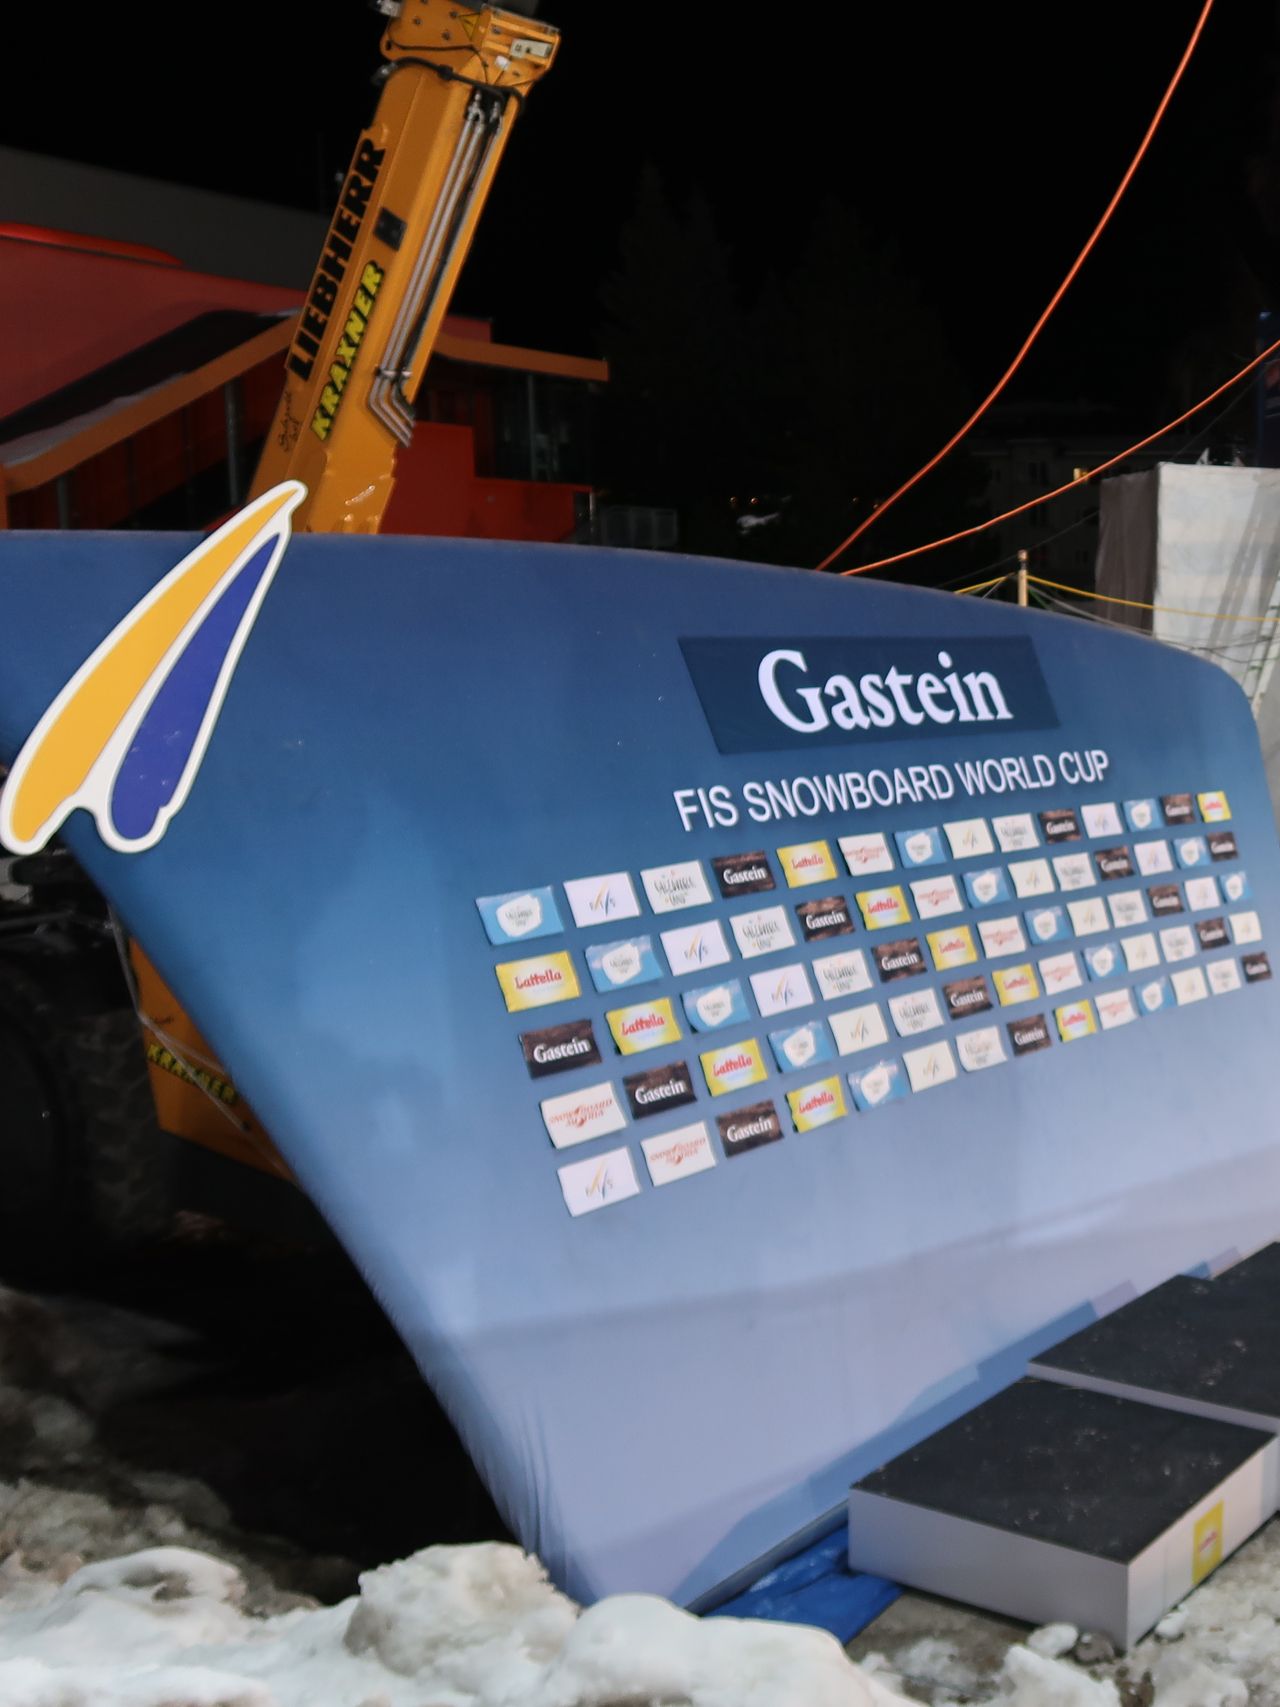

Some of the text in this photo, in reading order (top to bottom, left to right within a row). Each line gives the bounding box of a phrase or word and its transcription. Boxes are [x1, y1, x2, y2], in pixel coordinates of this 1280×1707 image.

[287, 137, 386, 383] LIEBHERR
[310, 259, 385, 441] KRAXNER
[758, 648, 1014, 734] Gastein
[673, 748, 1110, 833] FIS SNOWBOARD WORLD CUP
[723, 865, 768, 885] Gastein
[805, 910, 847, 930] Gastein
[881, 952, 919, 971] Gastein
[515, 968, 562, 990] Lattella
[621, 1013, 665, 1036] Lattella
[534, 1037, 591, 1064] Gastein
[713, 1055, 753, 1077] Lattella
[635, 1079, 687, 1105] Gastein
[726, 1114, 774, 1143] Gastein
